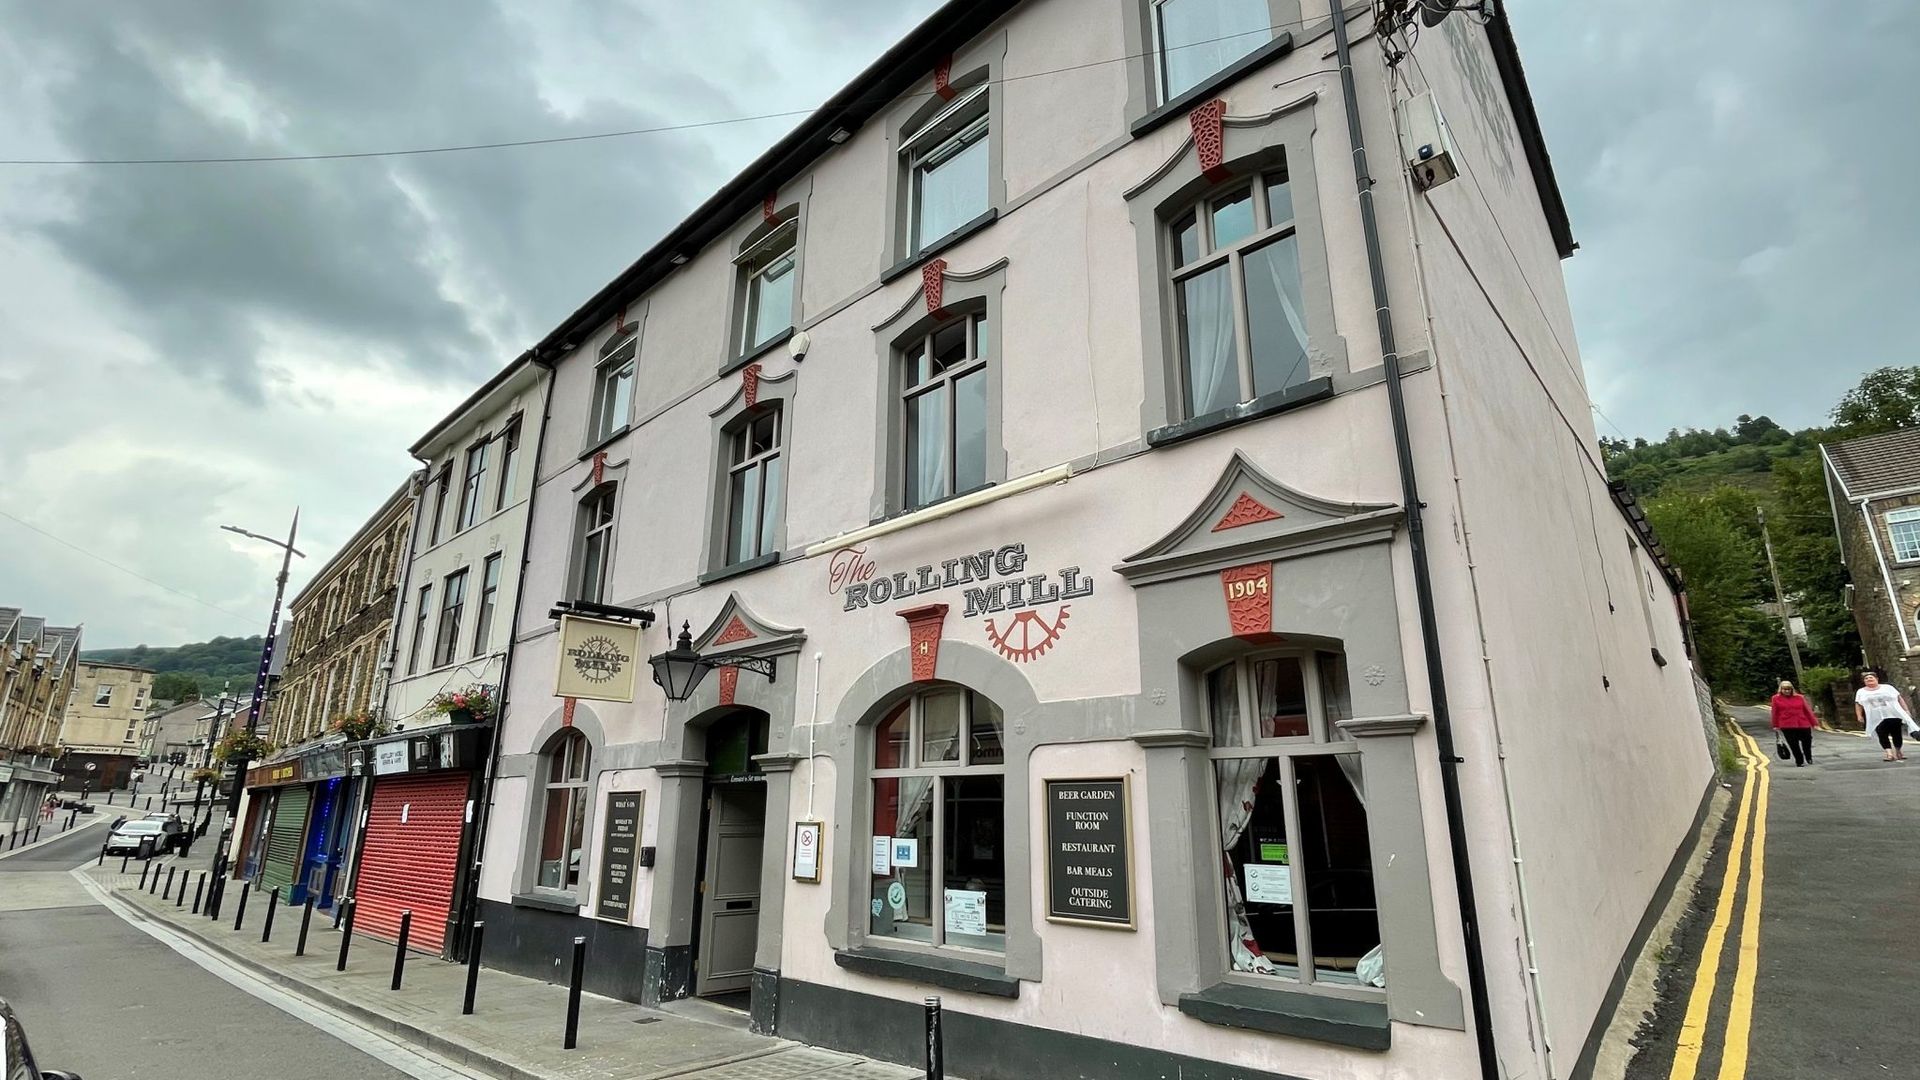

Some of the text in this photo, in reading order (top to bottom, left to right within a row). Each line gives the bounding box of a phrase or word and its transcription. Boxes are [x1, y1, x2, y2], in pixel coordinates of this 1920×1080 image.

[828, 546, 877, 595] The
[843, 541, 1028, 612] ROLLING
[962, 565, 1094, 618] MILL
[1228, 576, 1268, 599] 1904
[920, 641, 928, 655] H
[567, 648, 630, 663] ROLLING
[574, 658, 621, 673] MILL
[1058, 790, 1115, 800] BEER GARDEN
[1066, 812, 1109, 821] FUNCTION
[1075, 821, 1100, 831] ROOM
[1061, 843, 1116, 853] RESTAURANT
[1066, 866, 1113, 877] BAR MEALS
[1071, 887, 1109, 898] OUTSIDE
[1068, 897, 1112, 909] CATERING
